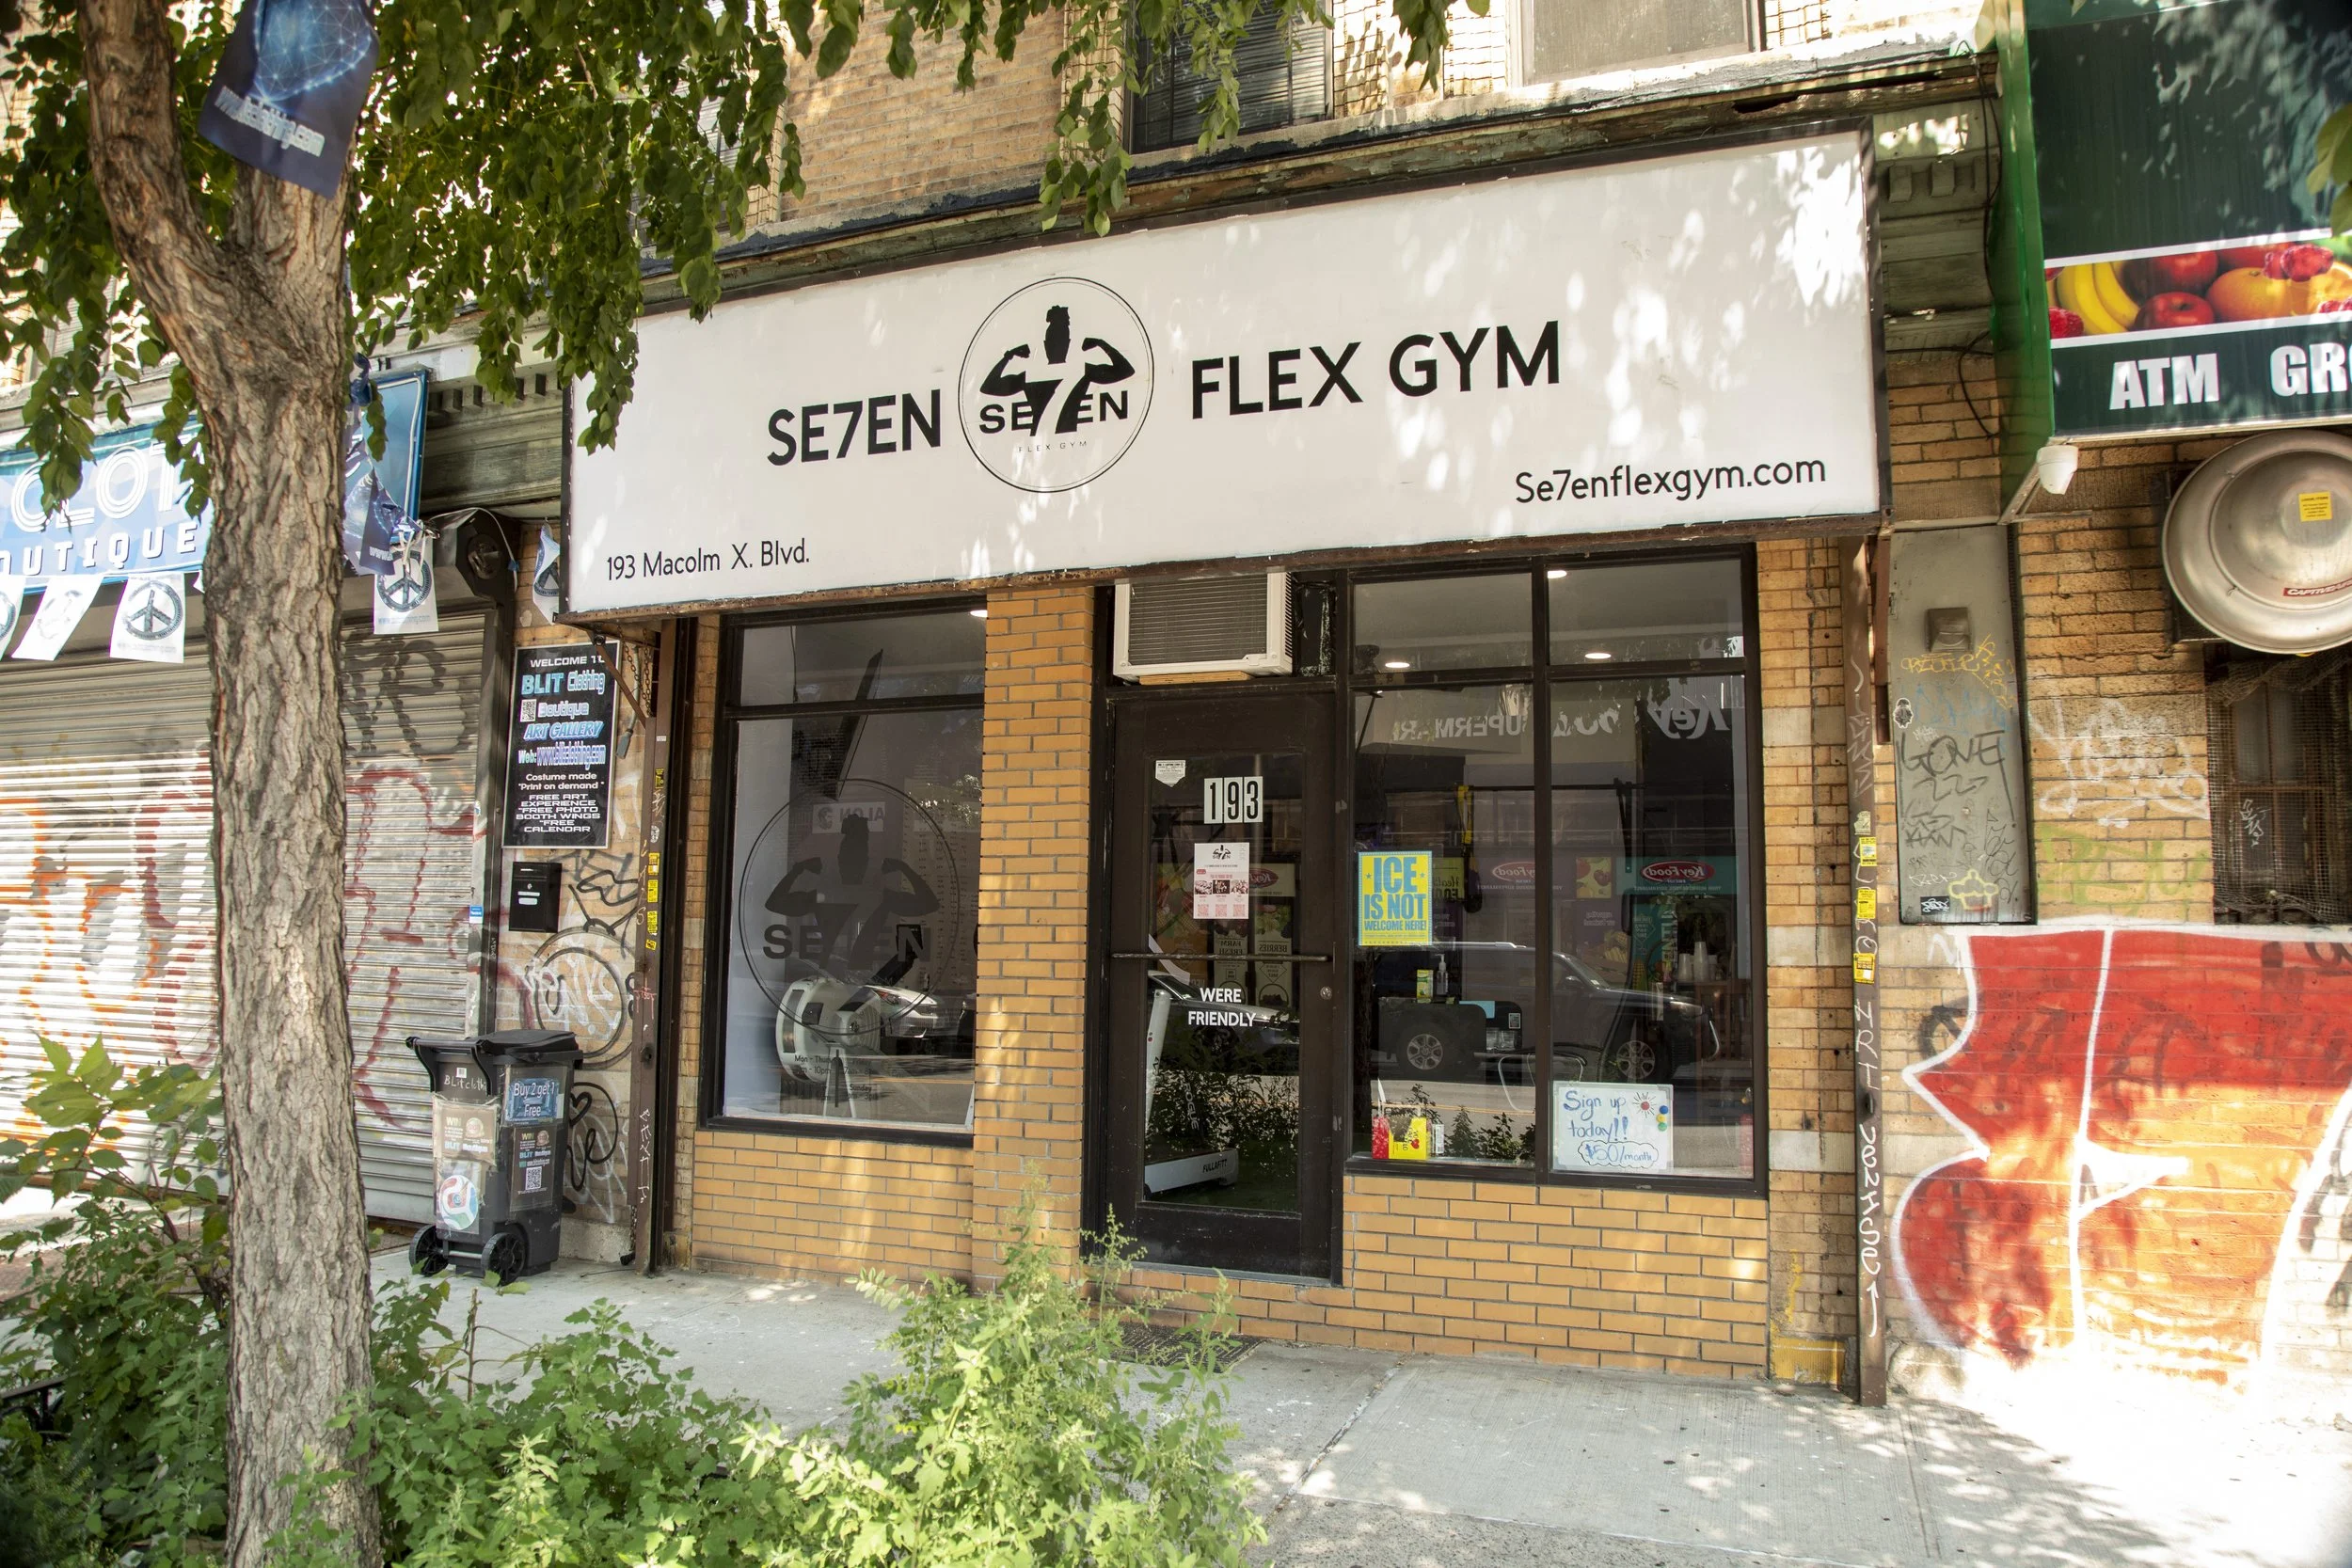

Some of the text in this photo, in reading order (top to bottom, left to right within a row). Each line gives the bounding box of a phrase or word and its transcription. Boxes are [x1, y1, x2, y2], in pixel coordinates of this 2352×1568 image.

[1192, 321, 1559, 420] FLEX GYM
[2109, 353, 2219, 410] ATM
[767, 388, 941, 467] SE7EN
[1018, 439, 1089, 453] FLEX GYM
[1516, 458, 1826, 504] Se7enflexgym.com
[607, 538, 810, 580] 193 Macolm X. Blvd.
[530, 656, 588, 668] WELCOME
[521, 669, 606, 696] BLIT Clothing
[537, 700, 589, 720] Boutique
[523, 721, 604, 741] ART GALLERY
[558, 782, 598, 790] demand
[1209, 780, 1259, 820] 193
[1374, 856, 1418, 894] ICE
[1364, 894, 1427, 920] IS NOT
[1364, 920, 1426, 930] WELCOME HERE!
[1200, 988, 1242, 1003] WERE
[1188, 1010, 1257, 1027] FRIENDLY
[514, 1082, 530, 1099] Buy
[531, 1082, 536, 1096] 2
[537, 1083, 550, 1099] get
[524, 1103, 542, 1117] Free
[1563, 1090, 1626, 1121] Sign up
[1567, 1117, 1629, 1143] today!!
